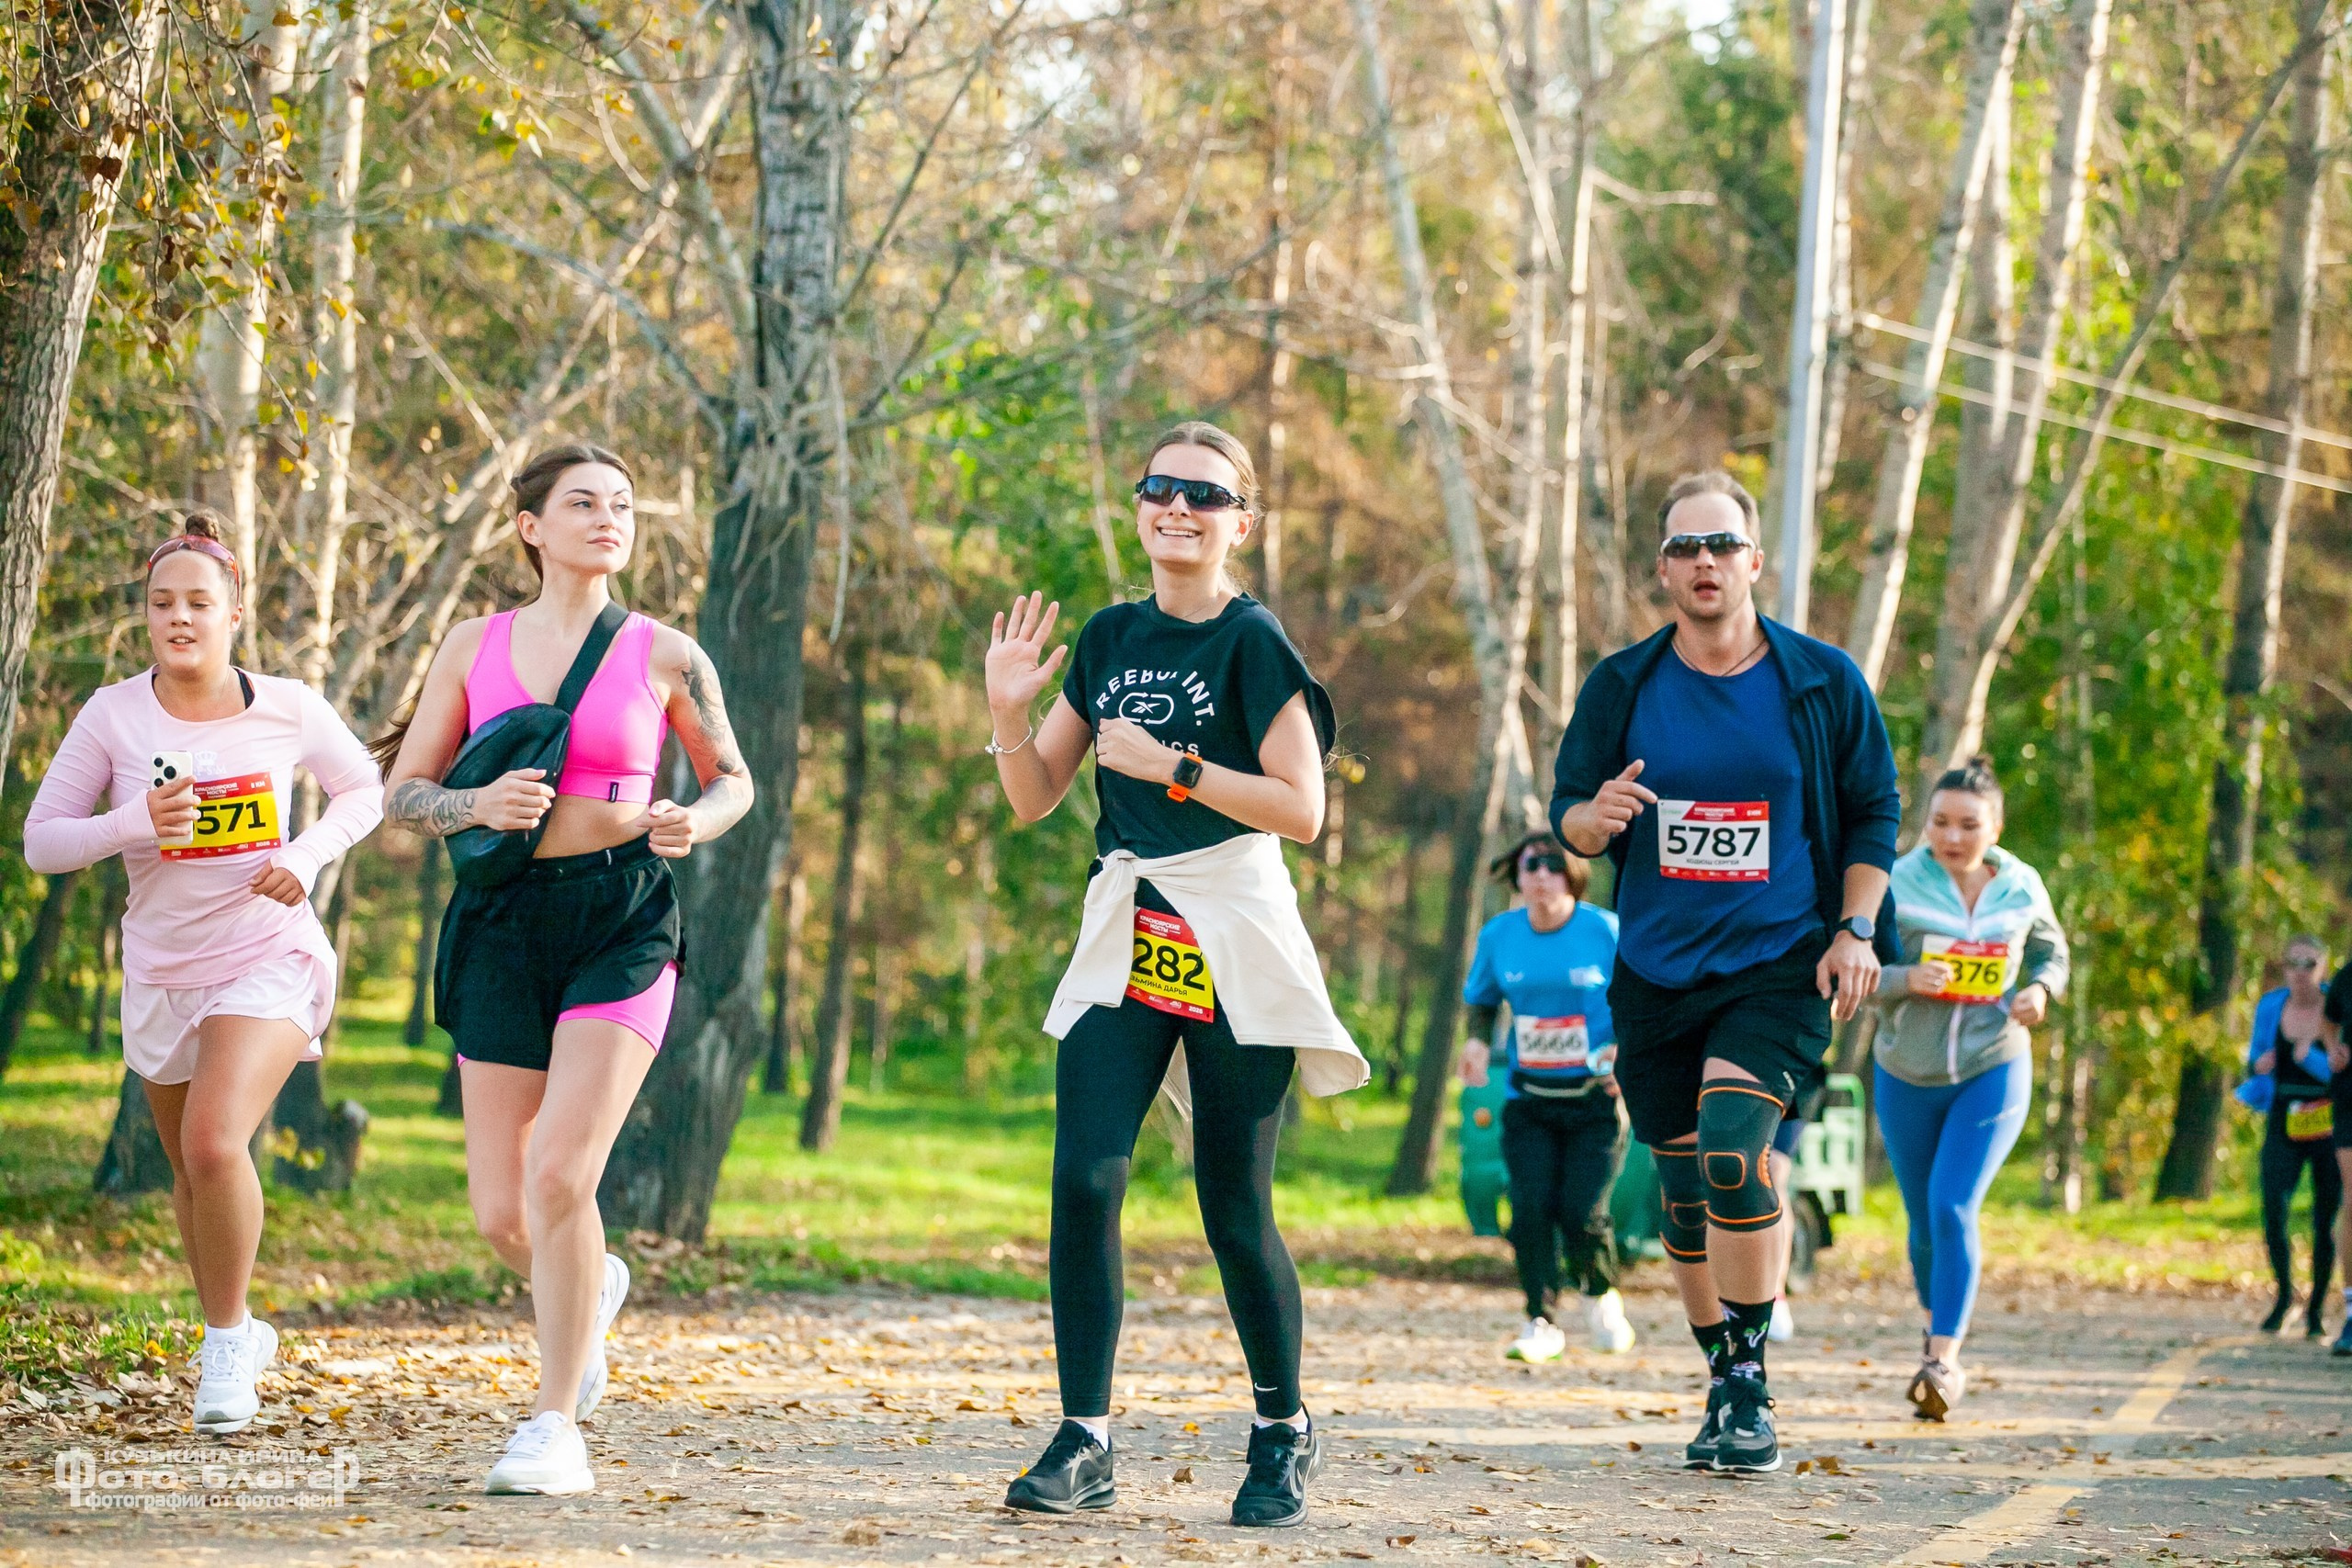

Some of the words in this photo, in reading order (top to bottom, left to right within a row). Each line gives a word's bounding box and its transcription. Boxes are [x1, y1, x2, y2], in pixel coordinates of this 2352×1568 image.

[1182, 671, 1216, 727] INT.
[193, 800, 266, 836] 571
[1668, 824, 1761, 857] 5787
[1131, 937, 1205, 991] 282
[1930, 957, 1999, 985] 376
[1164, 985, 1188, 996] ДАРЬЯ
